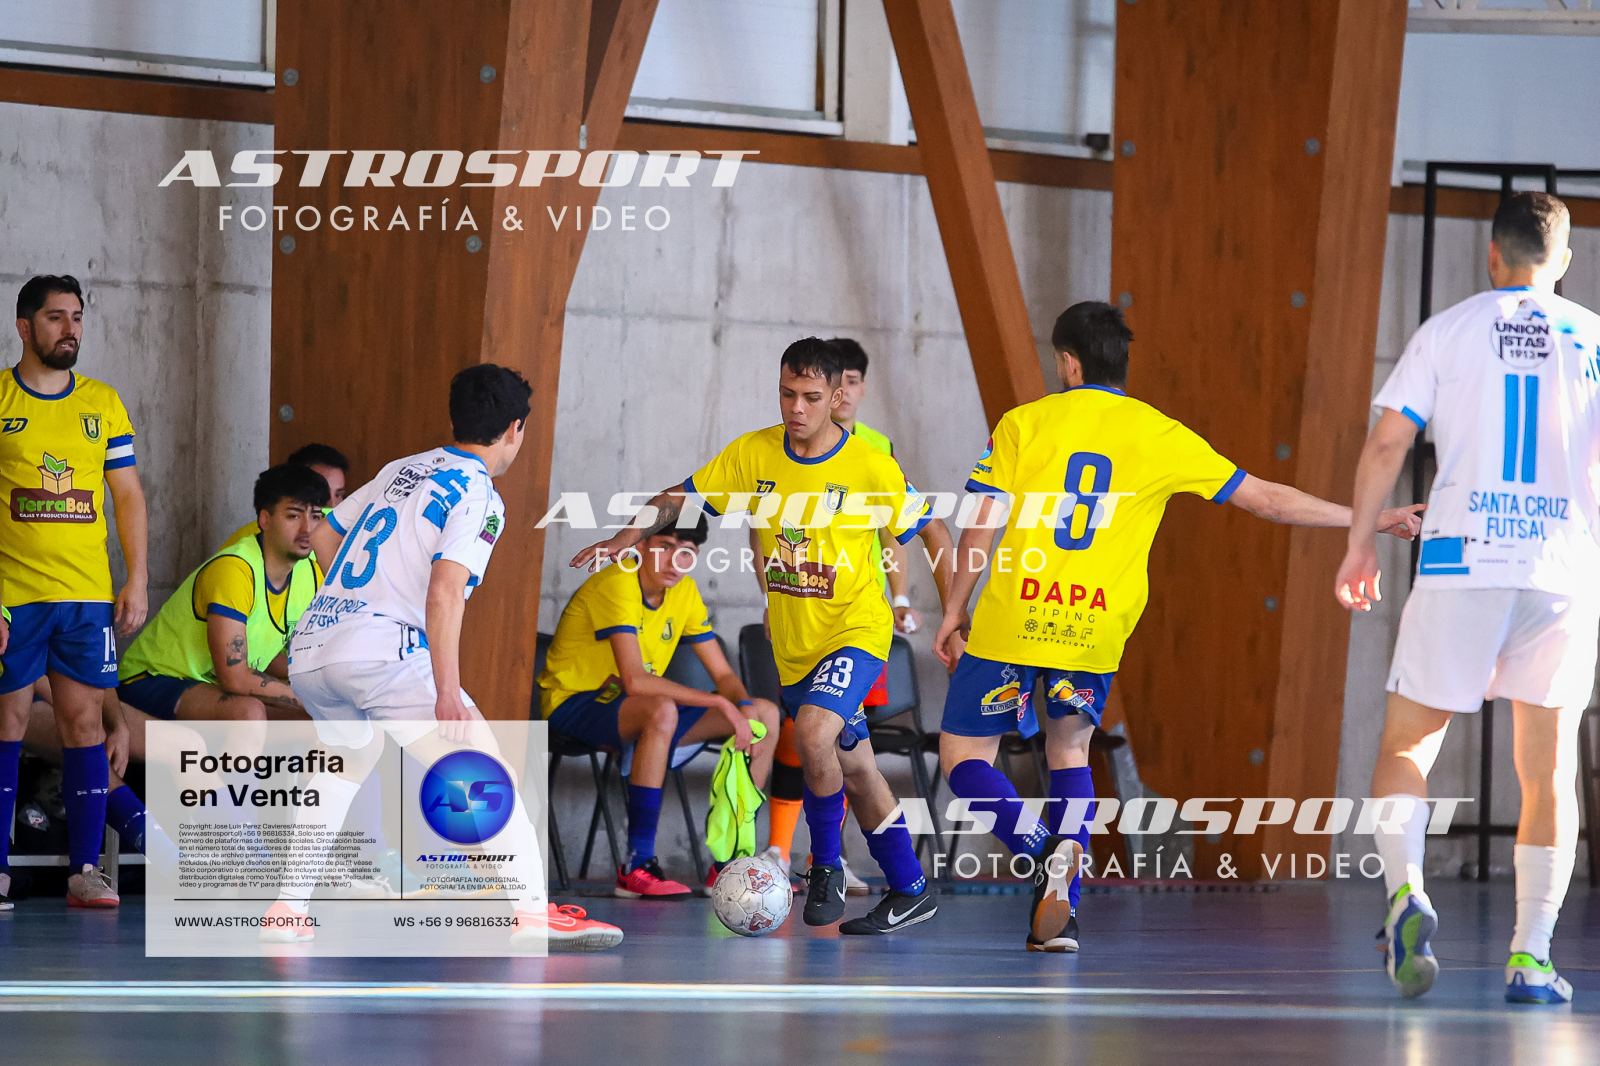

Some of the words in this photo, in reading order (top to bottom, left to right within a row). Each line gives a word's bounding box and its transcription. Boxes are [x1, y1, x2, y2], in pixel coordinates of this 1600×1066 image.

[1494, 321, 1550, 335] UNION
[1503, 374, 1538, 483] 11
[17, 496, 90, 513] TerraBox
[1054, 451, 1113, 551] 8
[1469, 491, 1520, 515] SANTA
[1525, 496, 1568, 520] CRUZ
[1487, 517, 1547, 541] FUTSAL
[324, 502, 398, 589] 13
[1020, 578, 1107, 611] DAPA
[1029, 606, 1095, 623] PIPING
[103, 626, 117, 662] 14
[813, 656, 854, 689] 23
[809, 684, 844, 698] ZADIA
